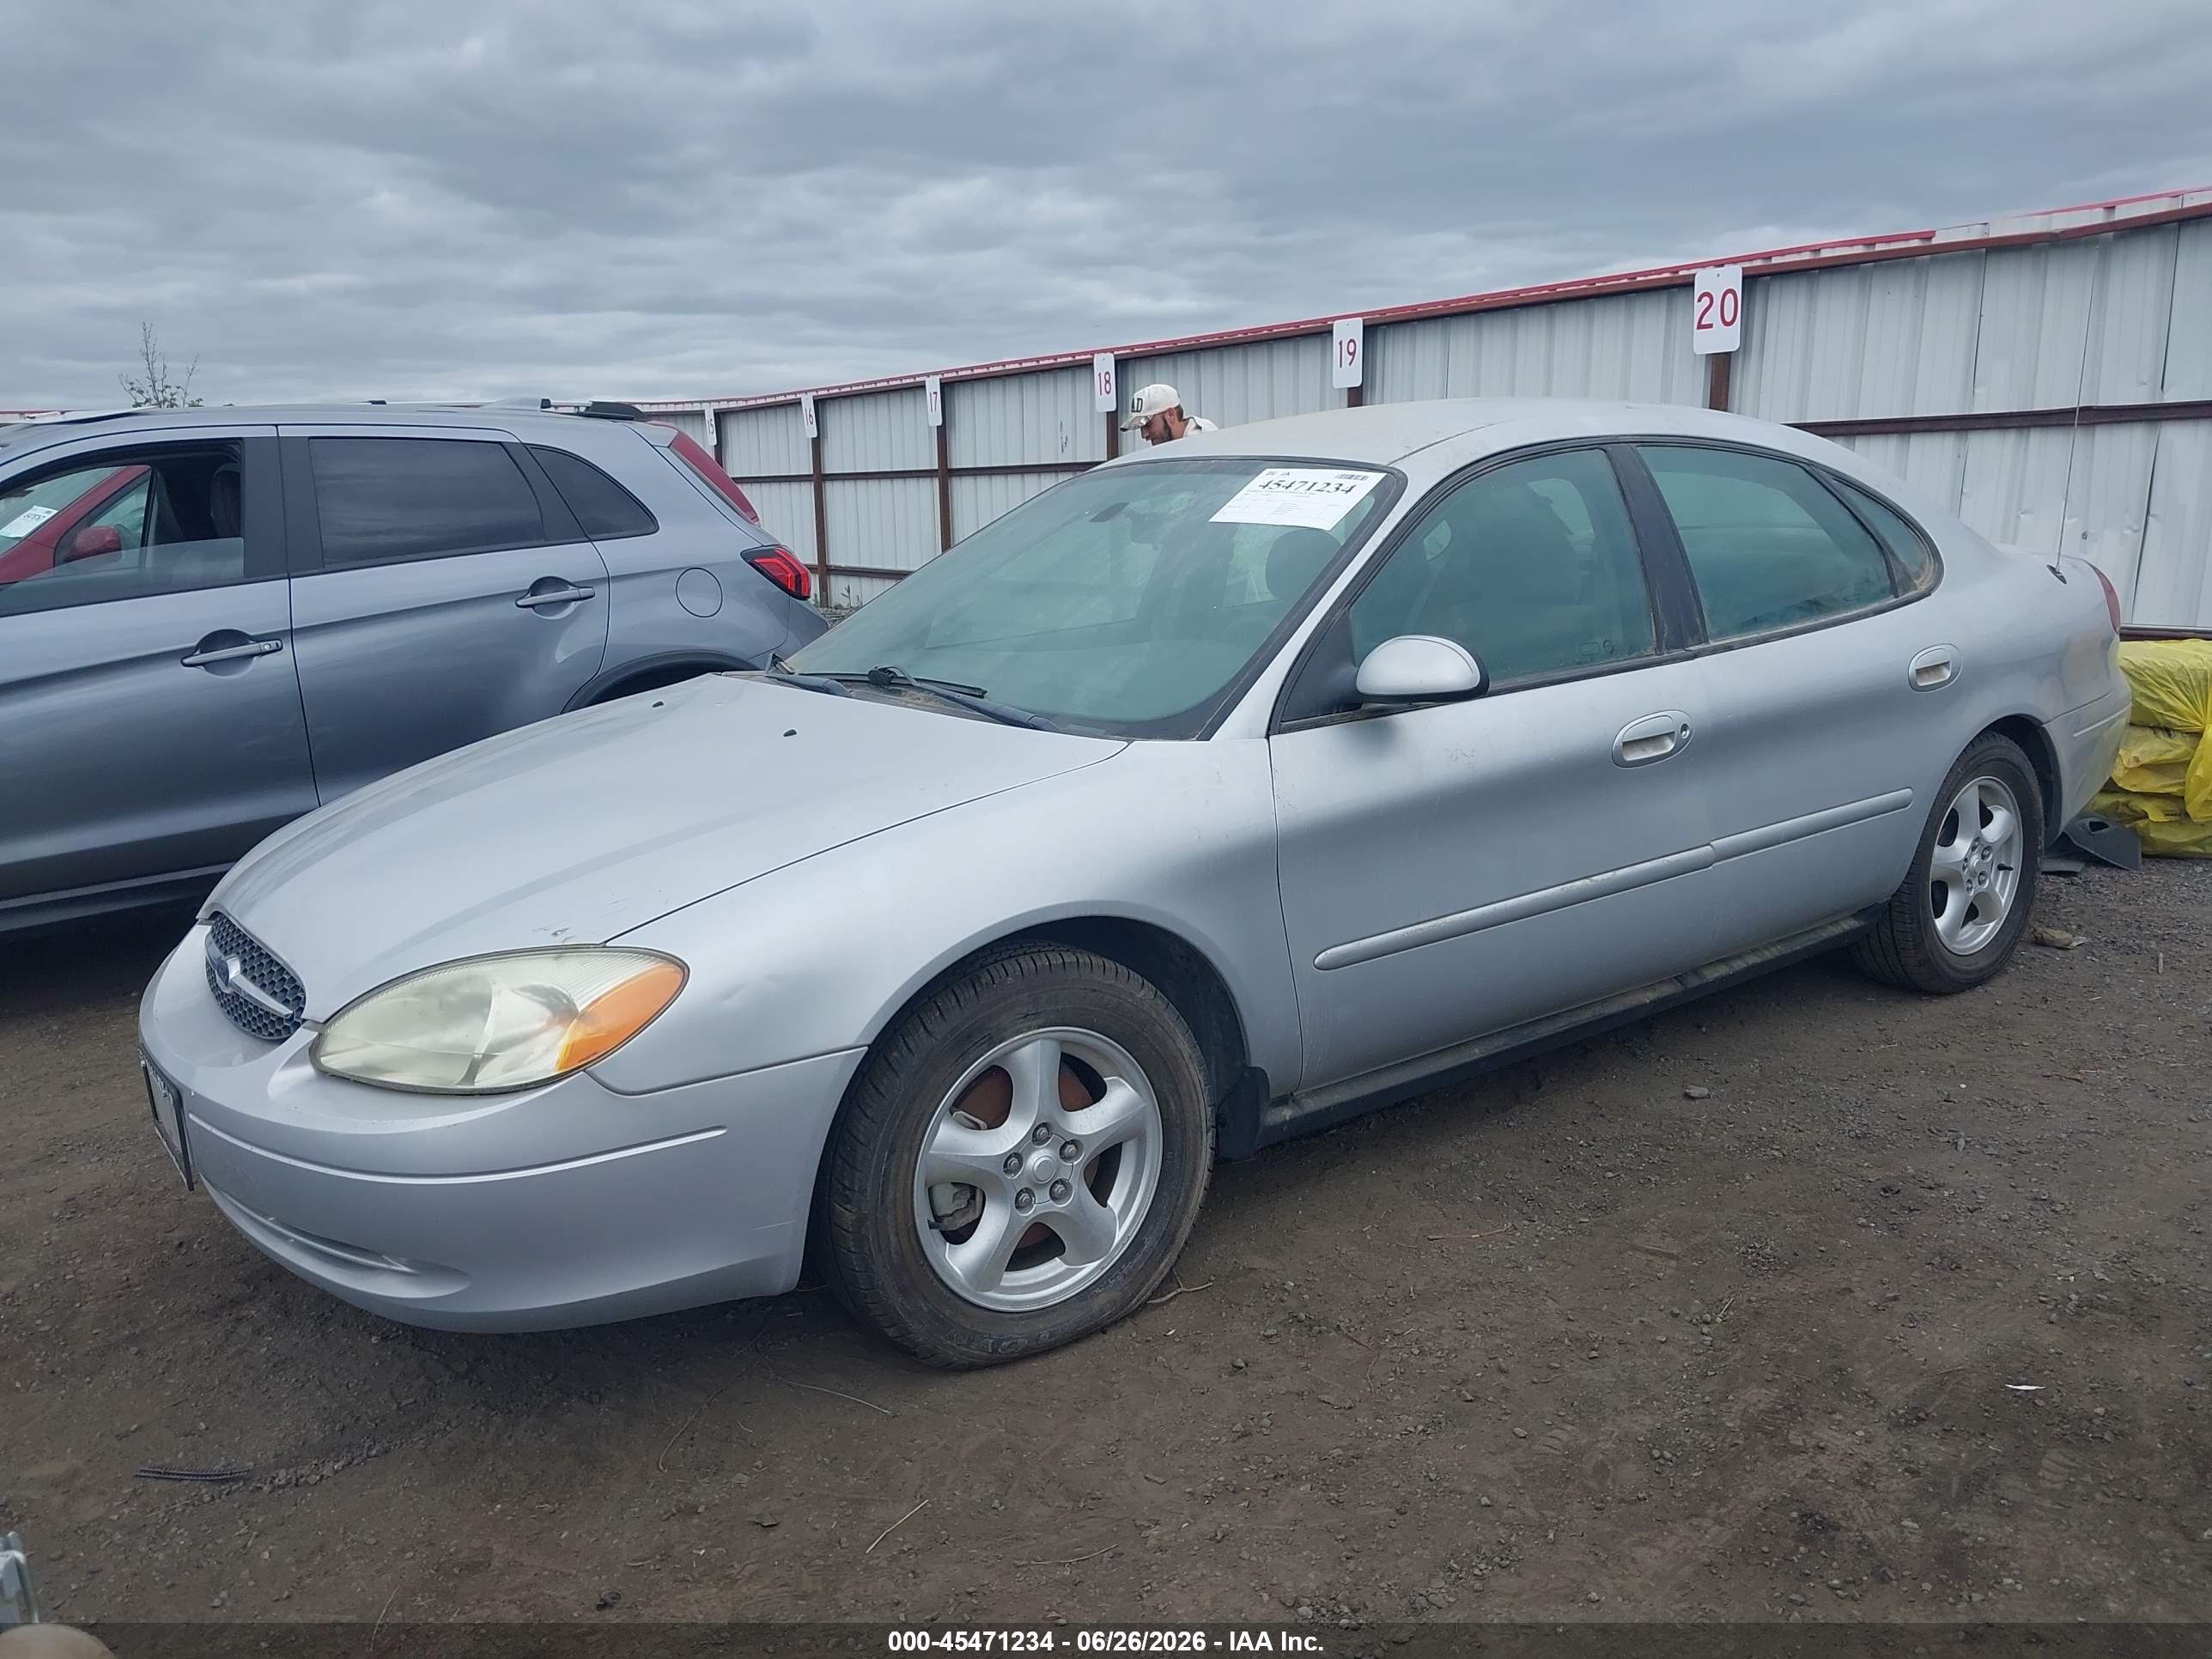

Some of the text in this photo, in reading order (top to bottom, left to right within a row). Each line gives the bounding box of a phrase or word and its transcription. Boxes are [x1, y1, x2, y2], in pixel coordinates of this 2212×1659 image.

[1696, 288, 1739, 331] 20
[1338, 337, 1357, 368] 19
[1097, 370, 1112, 397] 18
[929, 391, 939, 413] 17
[707, 418, 714, 435] 15
[805, 408, 814, 426] 16
[1258, 479, 1357, 495] 45471234
